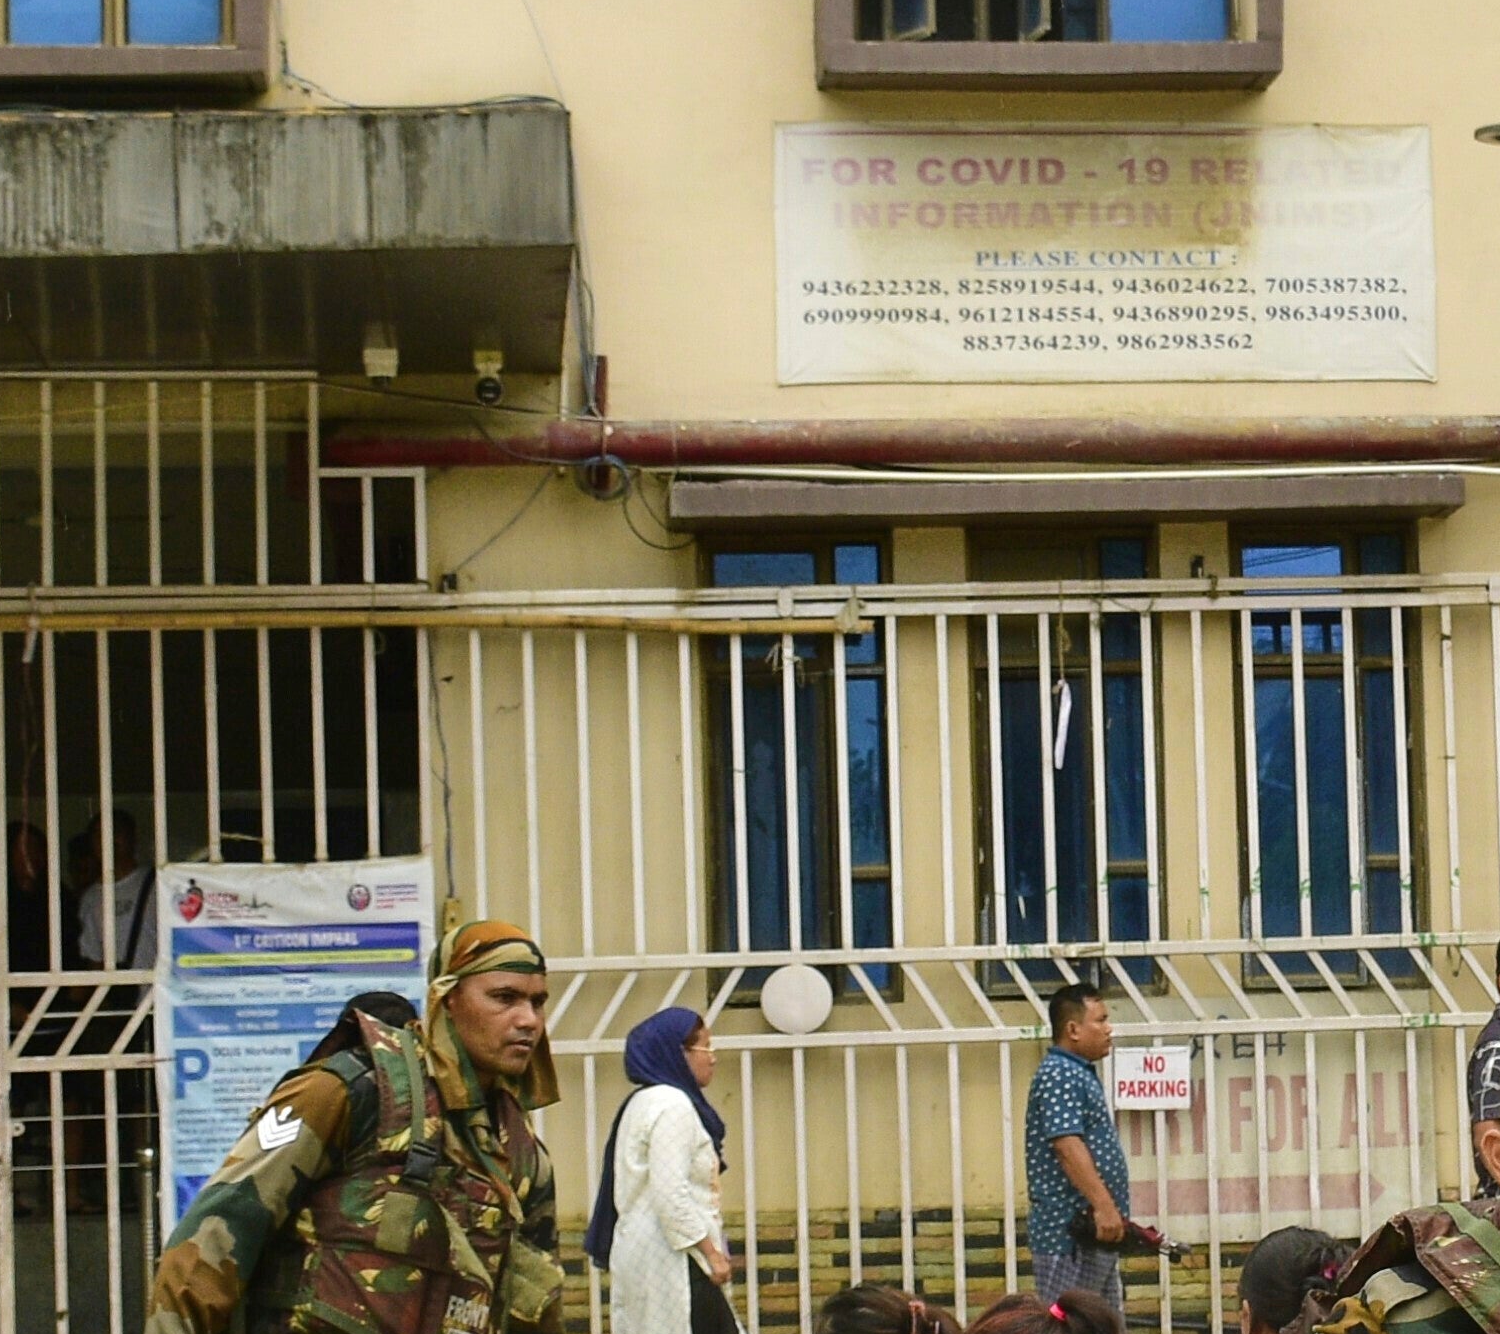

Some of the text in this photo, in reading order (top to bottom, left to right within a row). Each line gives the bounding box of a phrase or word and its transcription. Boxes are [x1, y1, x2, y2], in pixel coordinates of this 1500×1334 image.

[802, 157, 897, 186] FOR
[916, 157, 1066, 186] COVID
[1117, 157, 1170, 185] 19
[1190, 157, 1401, 185] RELATED
[834, 201, 1173, 229] INFORMATION
[975, 250, 1080, 267] PLEASE
[1089, 250, 1220, 267] CONTACT
[802, 277, 1408, 296] 9436232328, 8258919544, 9436024622, 7005387382,
[803, 305, 1408, 325] 6909990984, 9612184554, 9436890295, 9863495300,
[963, 333, 1253, 352] 8837364239, 9862983562
[1142, 1055, 1165, 1073] NO
[1117, 1079, 1188, 1098] PARKING
